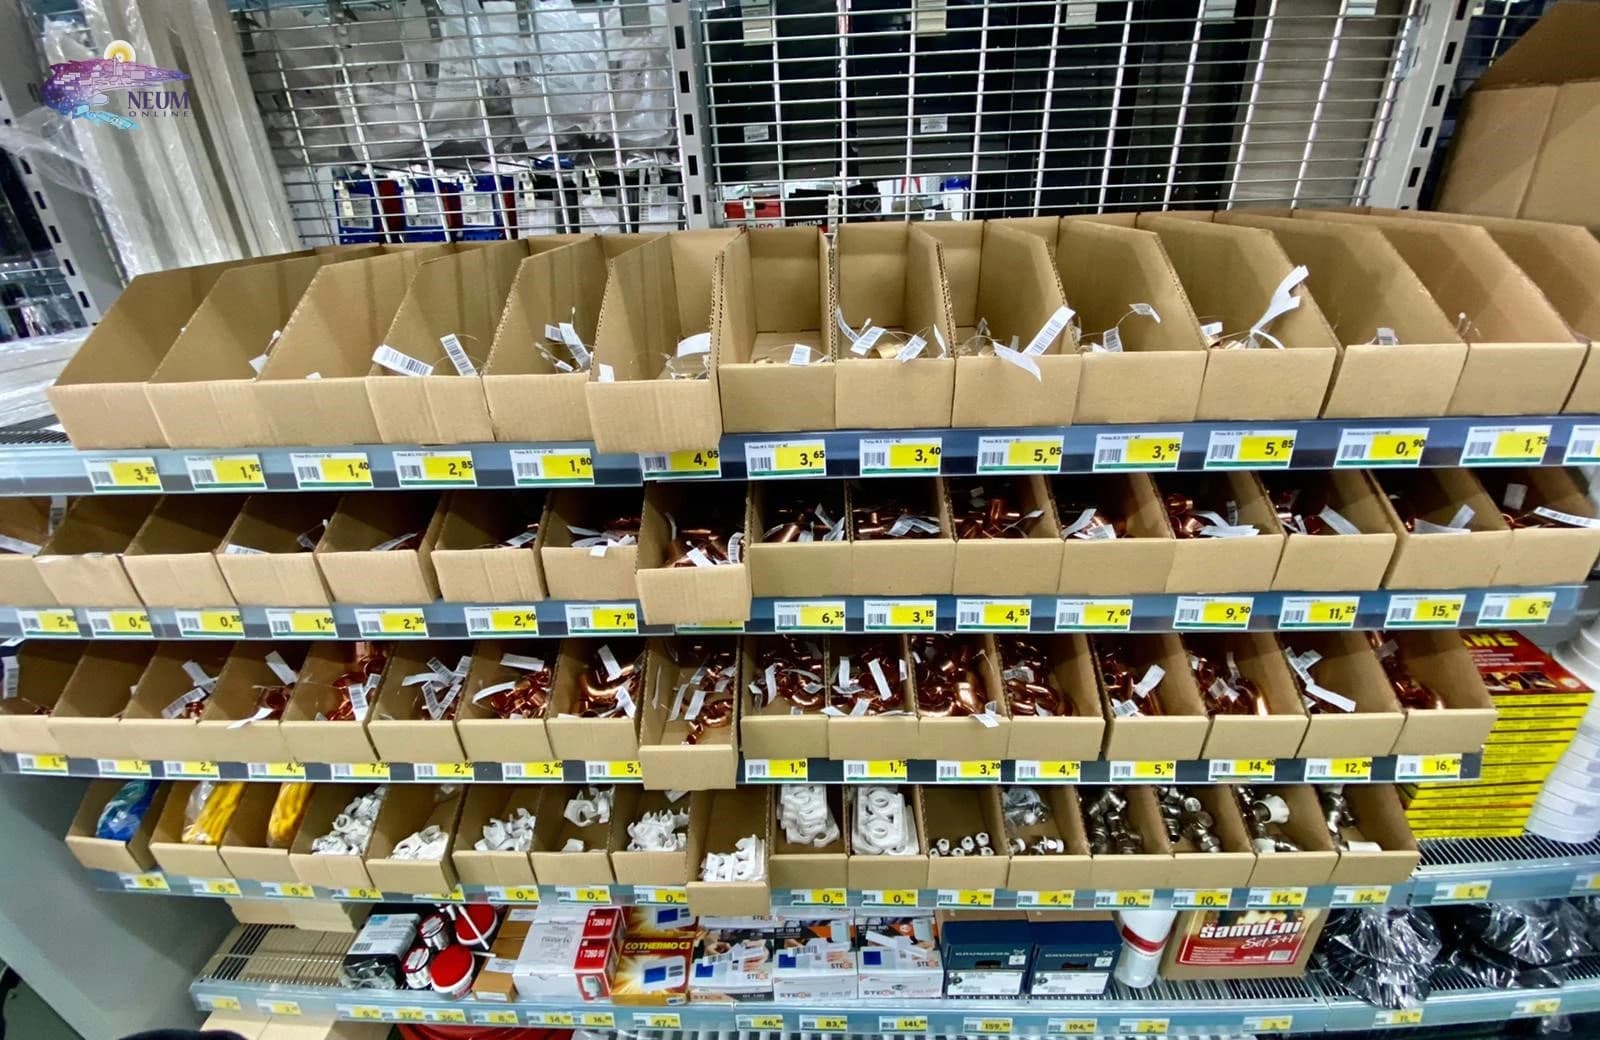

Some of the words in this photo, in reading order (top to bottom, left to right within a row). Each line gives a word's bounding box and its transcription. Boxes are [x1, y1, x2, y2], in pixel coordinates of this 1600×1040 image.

[1152, 444, 1180, 461] 3,95
[1264, 440, 1293, 457] 5,85
[1395, 439, 1425, 456] 0,90
[1524, 437, 1548, 453] 1,75
[694, 450, 719, 467] 4,05
[800, 450, 826, 466] 3,65
[915, 447, 941, 463] 3,40
[1034, 447, 1061, 463] 5,05
[348, 464, 370, 478] 1,40
[449, 461, 473, 478] 2,85
[569, 457, 593, 474] 1,80
[614, 612, 635, 627] 7,10
[822, 611, 845, 625] 6,35
[913, 609, 934, 624] 3,15
[1005, 608, 1030, 623] 4,55
[1107, 608, 1131, 623] 7,60
[1226, 606, 1251, 621] 9,50
[627, 762, 641, 775] 5,1
[790, 762, 806, 774] 1,10
[1154, 763, 1174, 776] 5,10
[625, 942, 678, 951] COTHERMO
